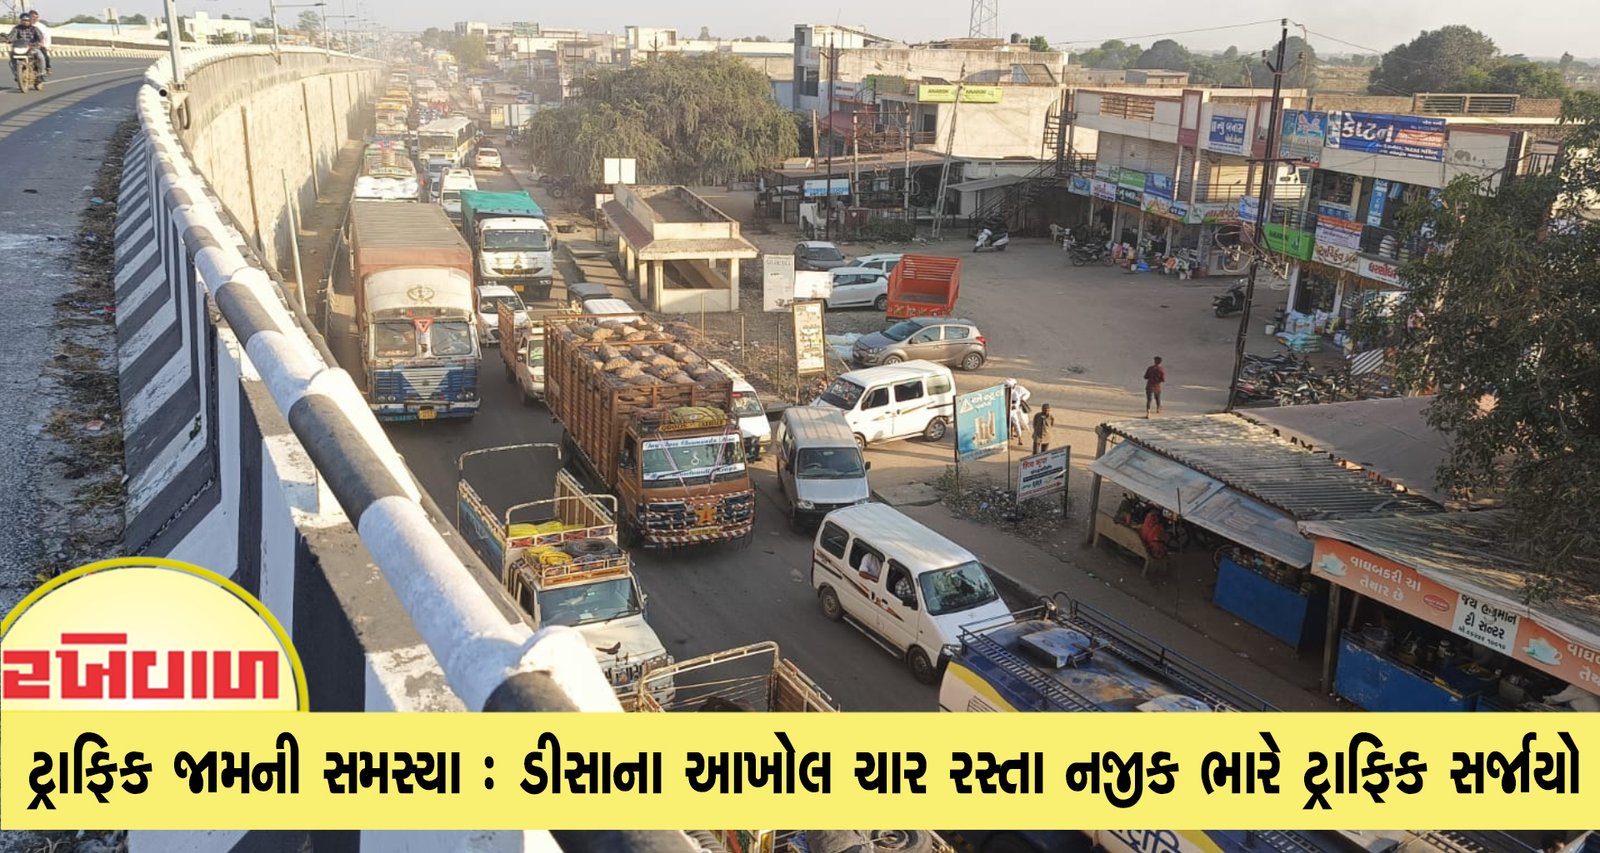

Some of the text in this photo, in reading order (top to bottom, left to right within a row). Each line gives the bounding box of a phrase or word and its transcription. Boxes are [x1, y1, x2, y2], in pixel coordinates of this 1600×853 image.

[1350, 556, 1421, 592] વાઘબકરી ચા
[1461, 594, 1478, 609] જય
[1464, 611, 1475, 627] ટી
